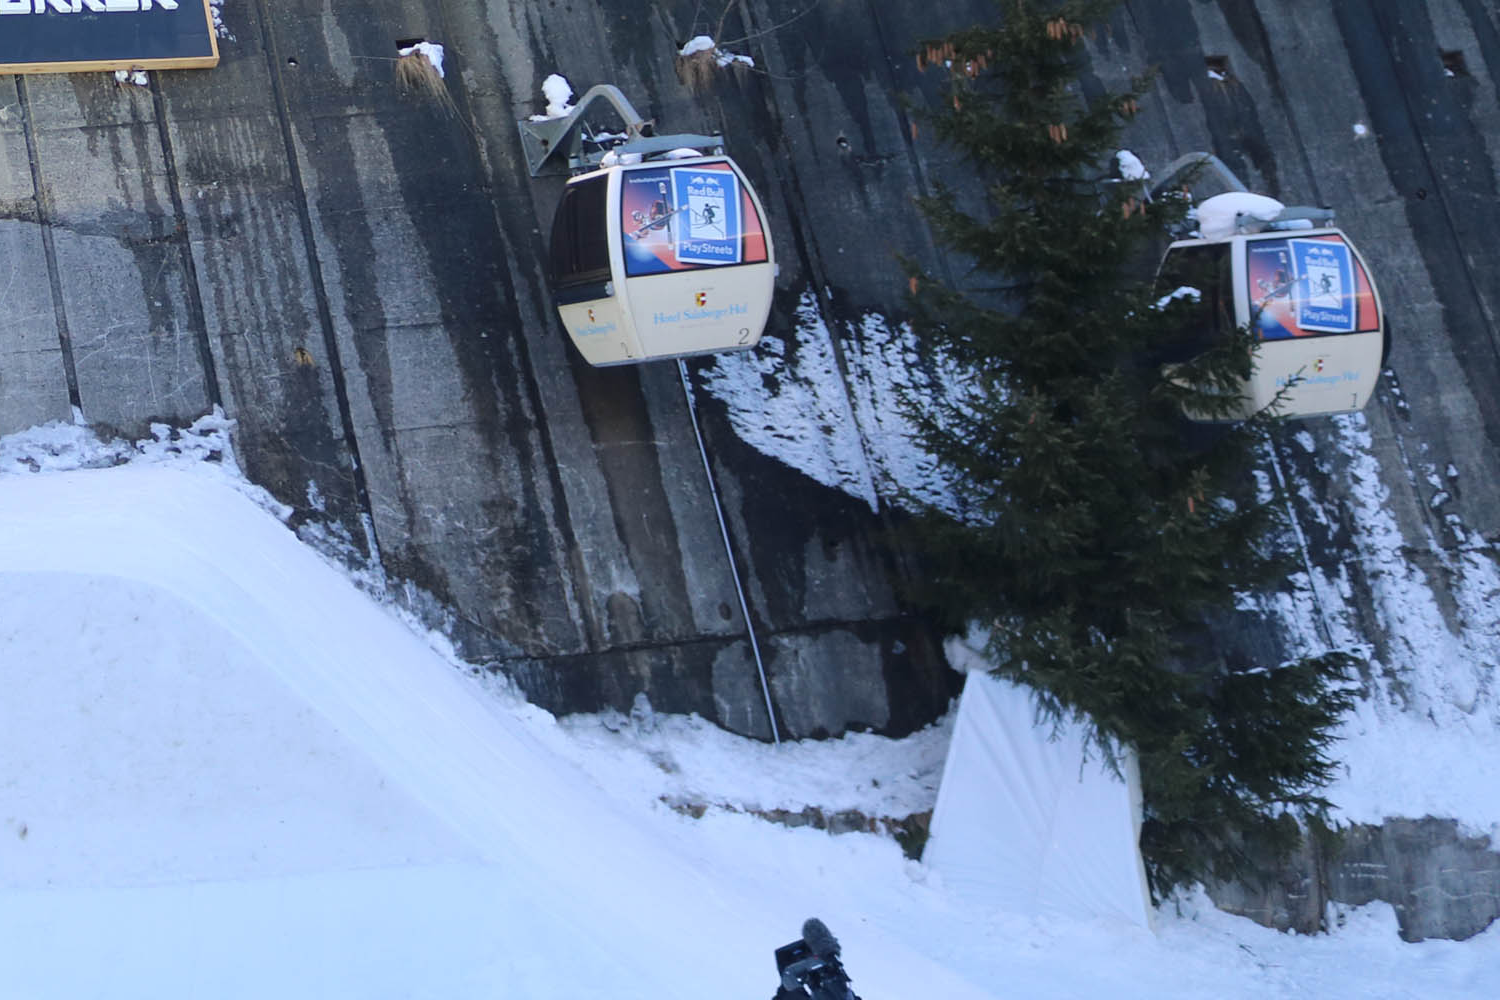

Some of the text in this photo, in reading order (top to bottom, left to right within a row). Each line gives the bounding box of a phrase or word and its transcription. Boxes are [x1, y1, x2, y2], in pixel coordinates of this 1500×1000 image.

[687, 186, 725, 197] Red Bull
[738, 327, 750, 345] 2
